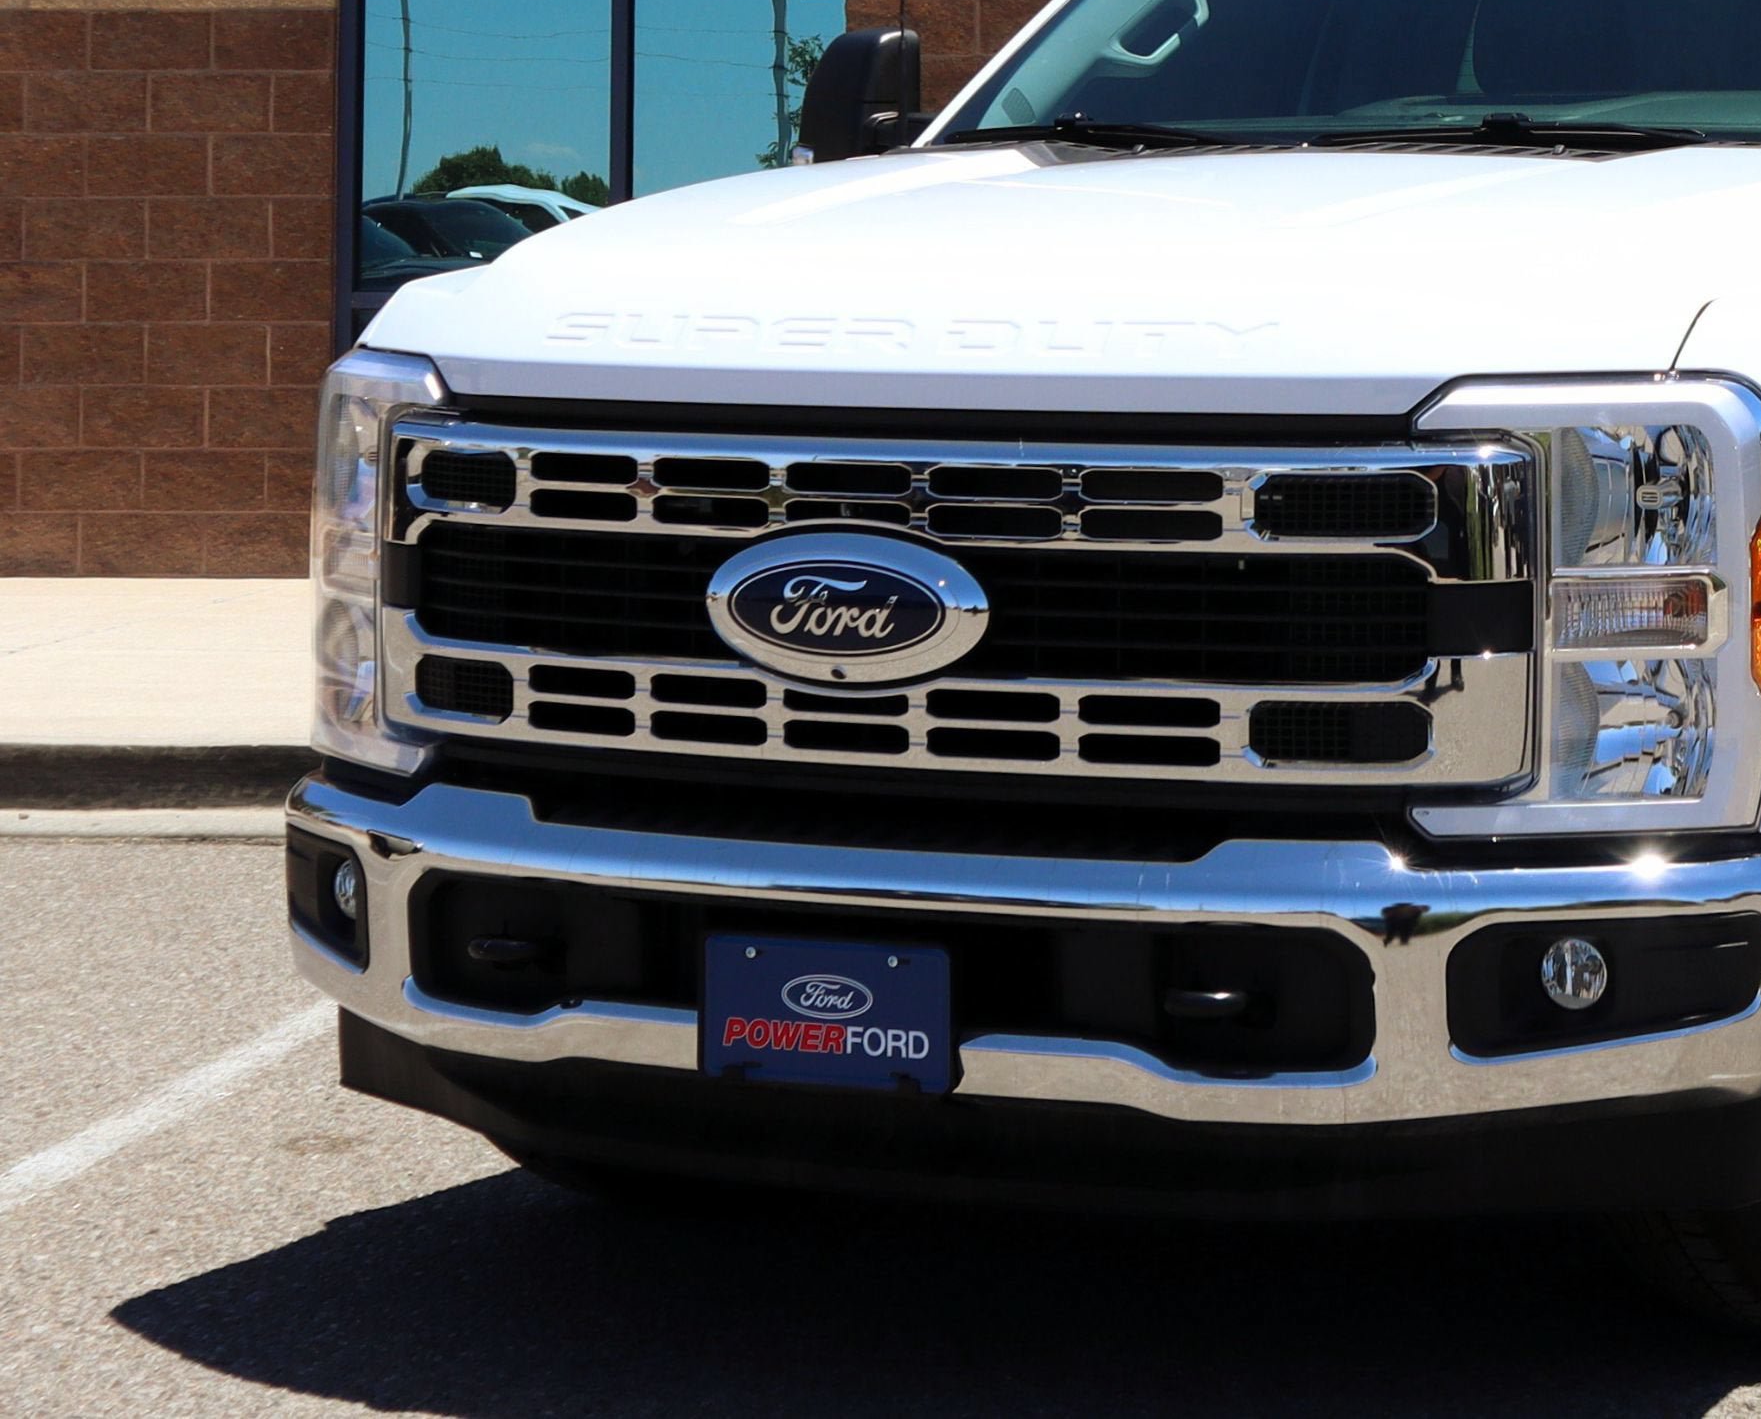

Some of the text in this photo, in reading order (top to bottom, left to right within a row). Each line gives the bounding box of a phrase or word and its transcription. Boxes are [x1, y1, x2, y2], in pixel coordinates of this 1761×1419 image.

[543, 308, 1282, 359] SUPER DUTY
[769, 575, 899, 638] Ford
[800, 981, 854, 1011] Ford
[722, 1016, 930, 1060] POWERFORD
